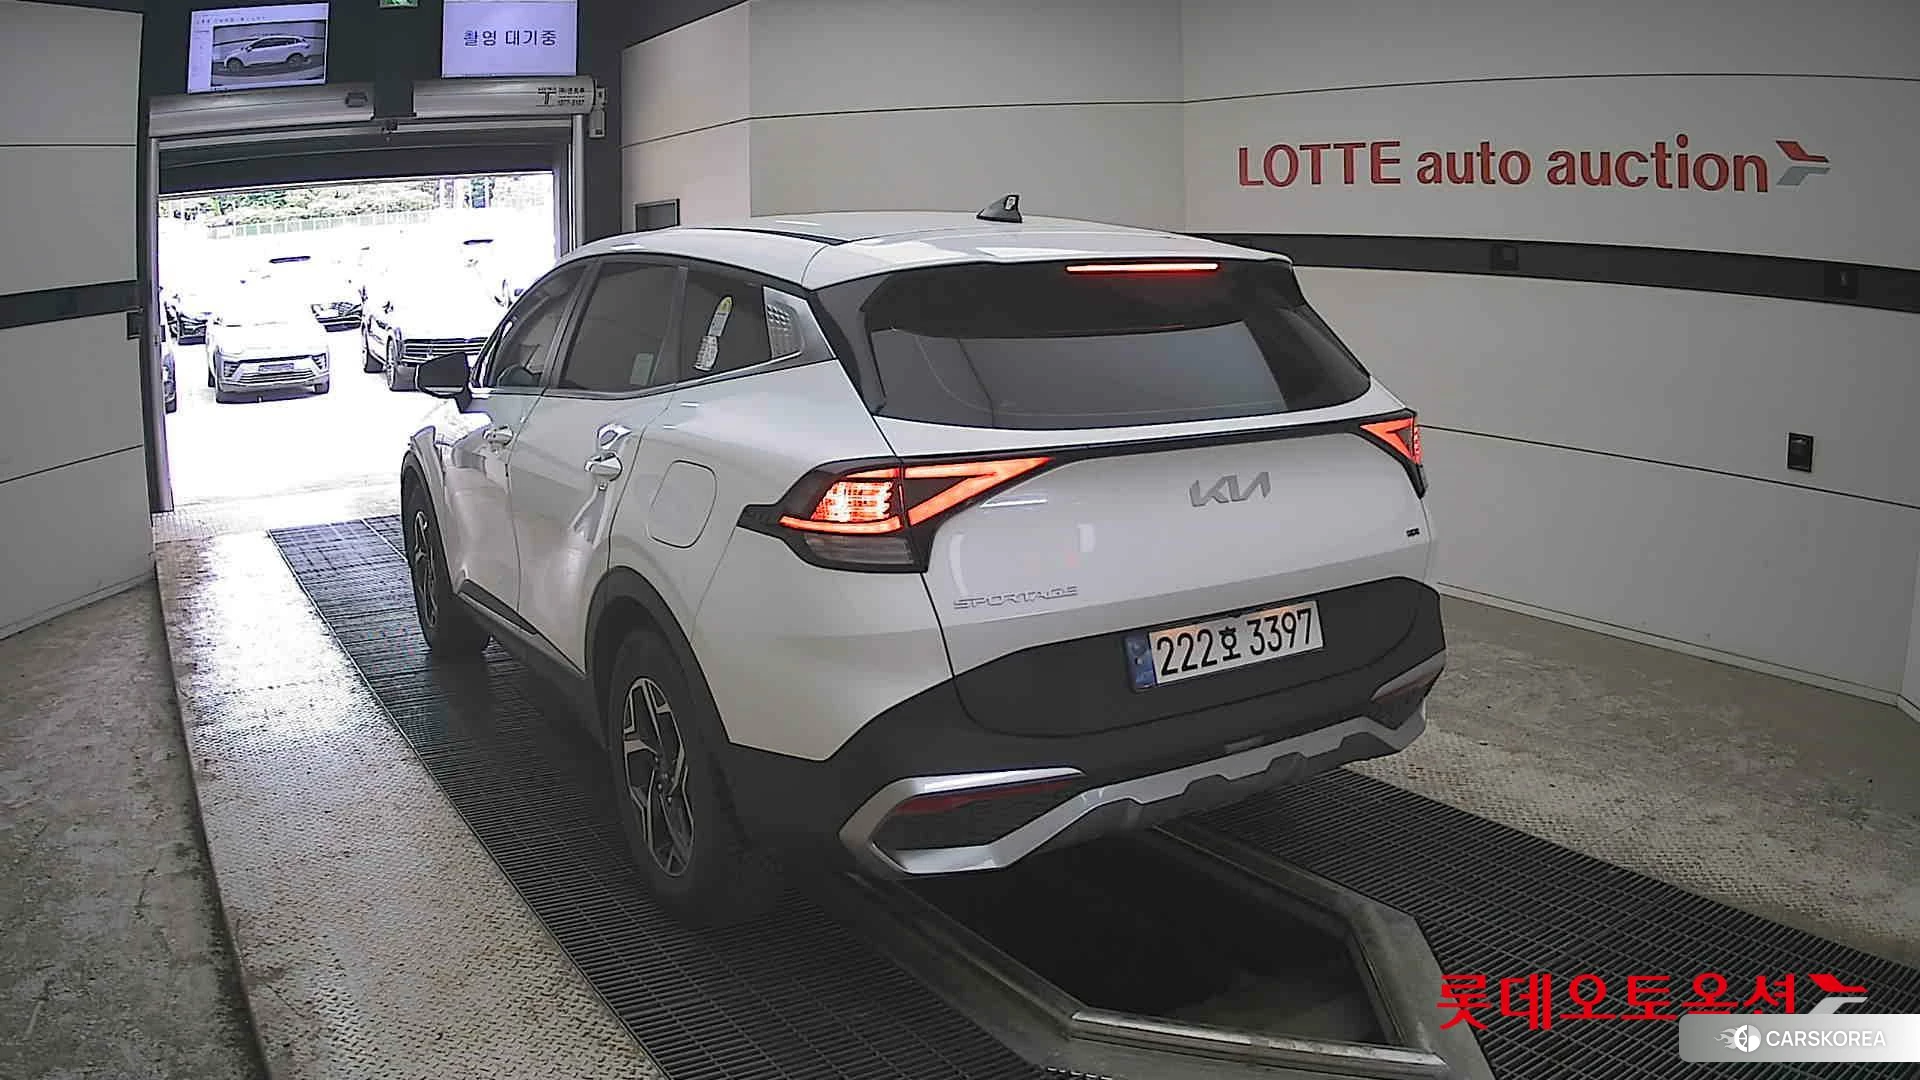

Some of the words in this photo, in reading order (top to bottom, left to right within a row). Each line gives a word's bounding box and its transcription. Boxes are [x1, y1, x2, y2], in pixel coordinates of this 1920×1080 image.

[463, 30, 497, 47] 촬영
[505, 29, 557, 46] 대기중
[1238, 140, 1401, 187] LOTTE
[1415, 140, 1531, 186] auto
[1546, 133, 1769, 193] auction
[953, 584, 1079, 610] SPORTAGE
